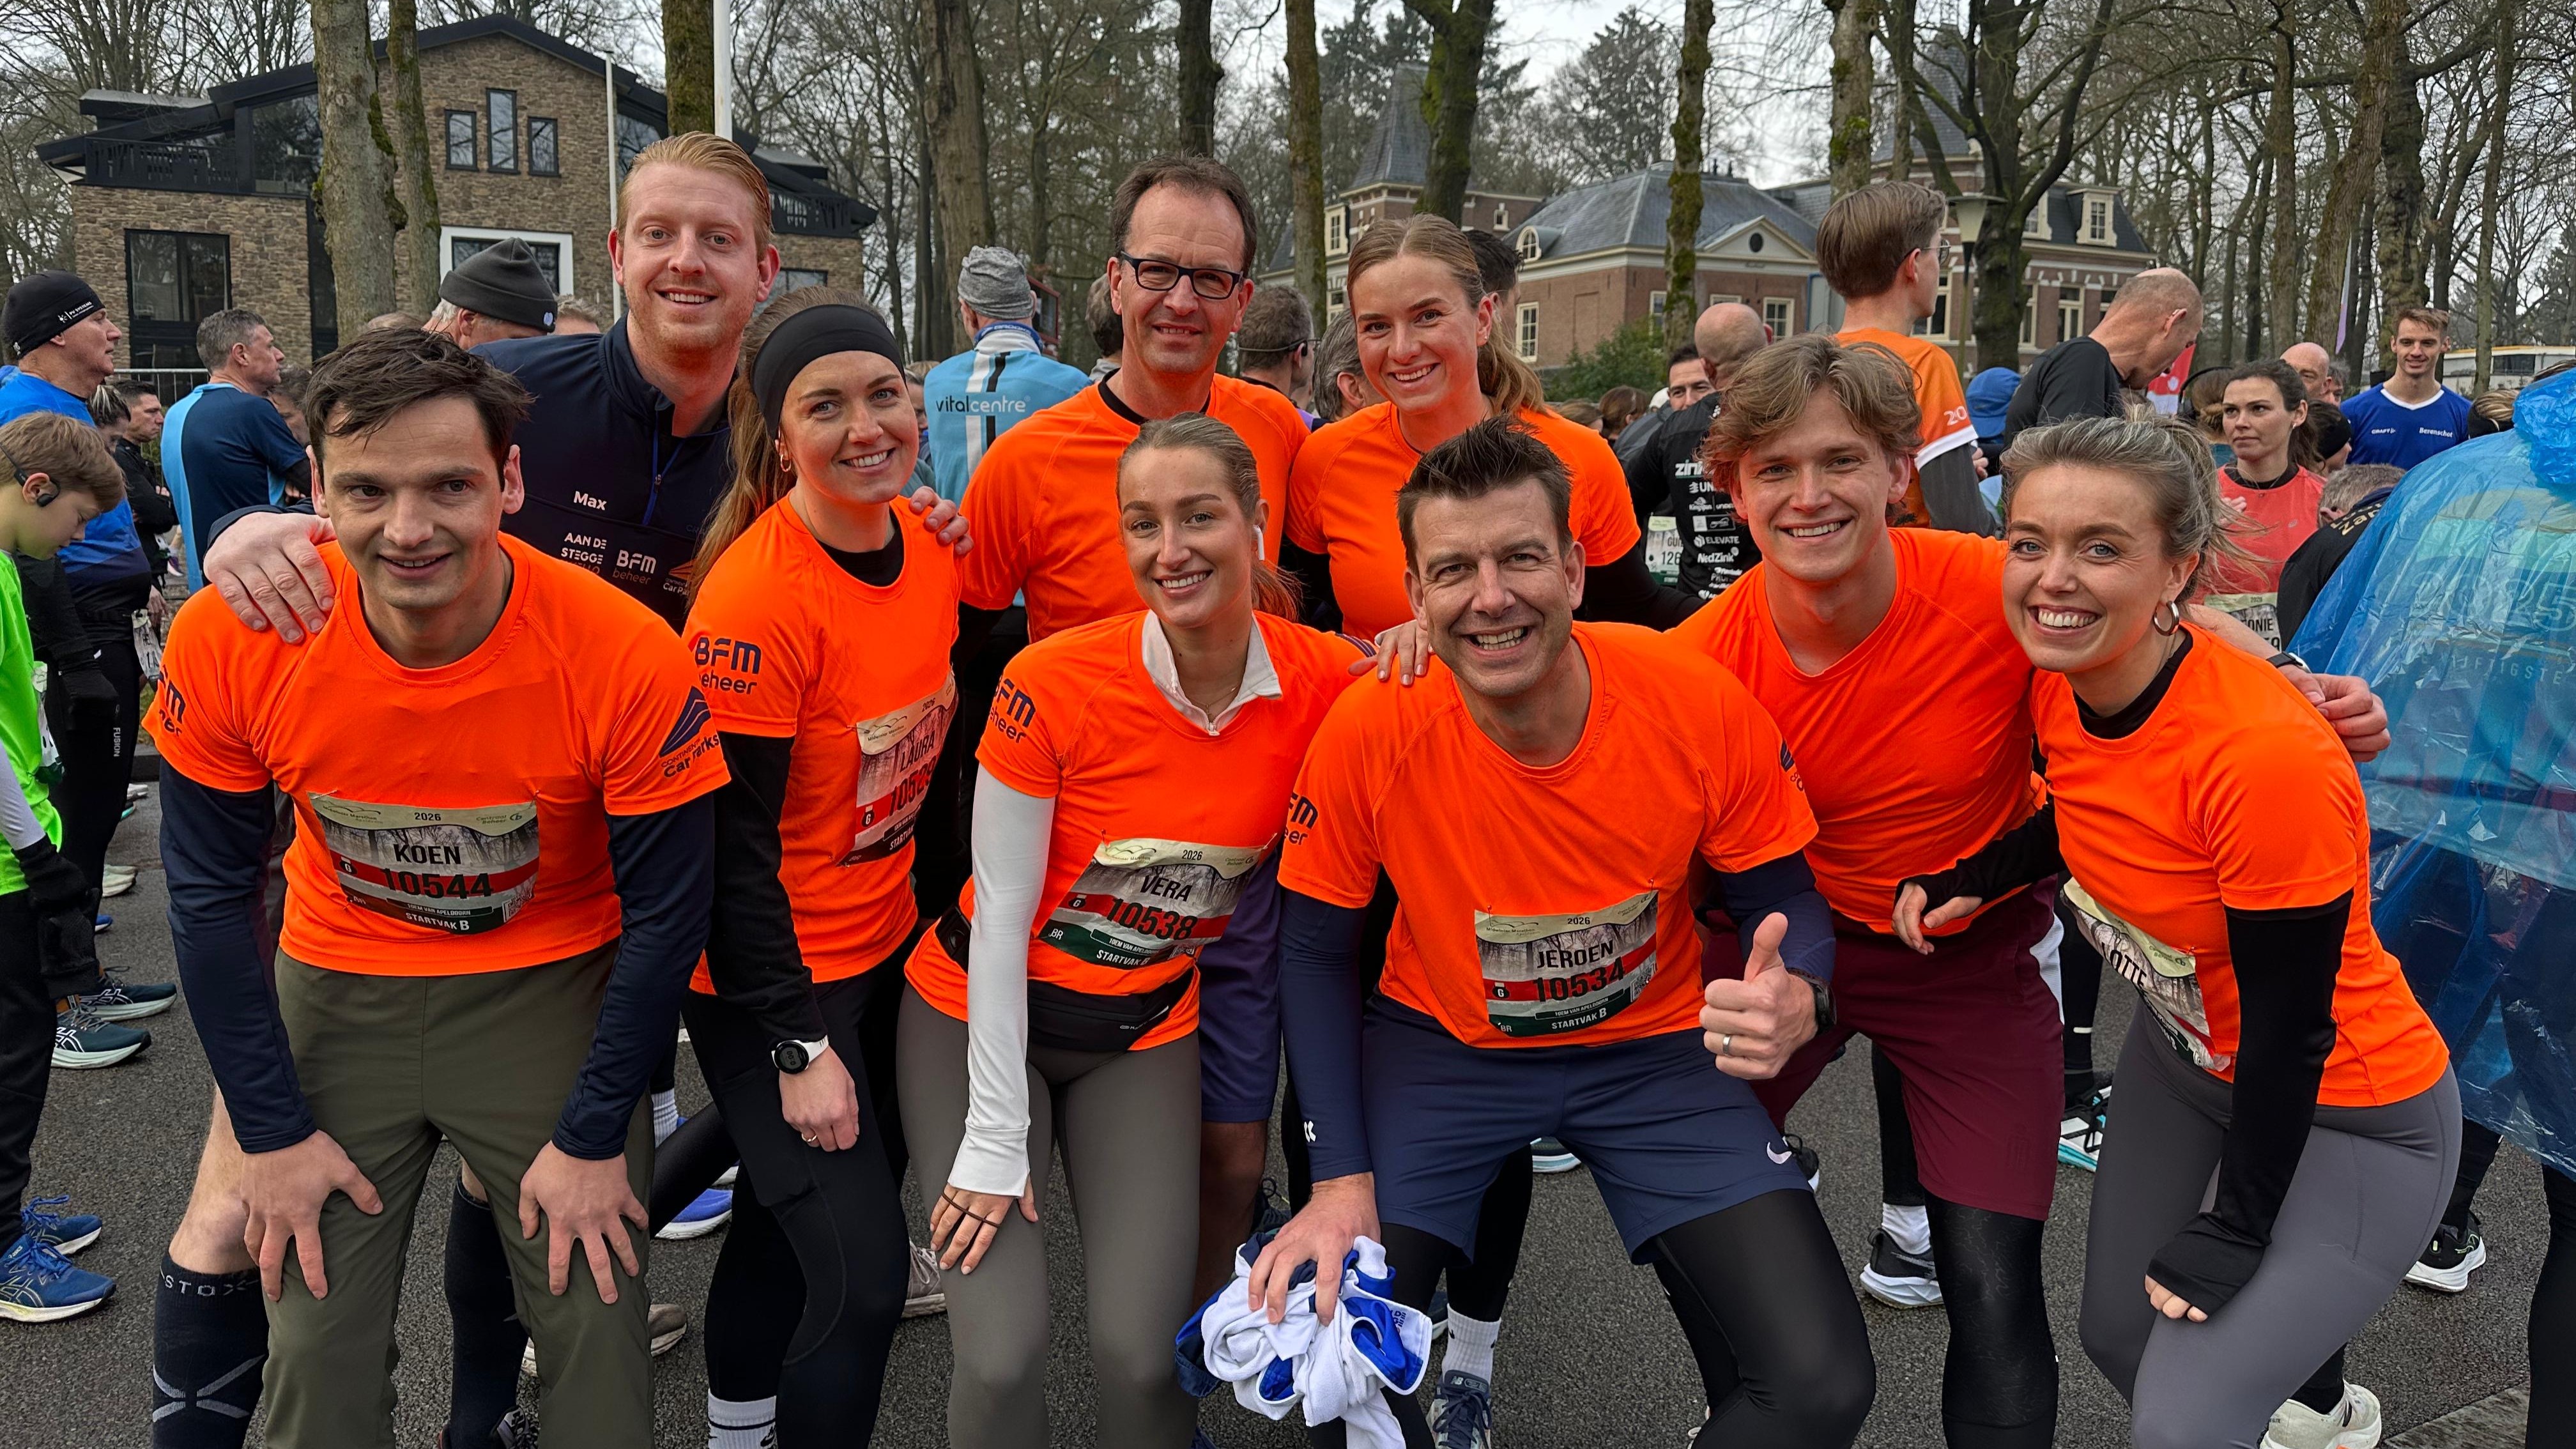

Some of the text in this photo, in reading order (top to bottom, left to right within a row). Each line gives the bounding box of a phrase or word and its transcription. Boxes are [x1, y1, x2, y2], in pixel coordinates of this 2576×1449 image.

[2419, 427, 2453, 438] Berenschot
[574, 491, 607, 510] Max
[564, 533, 607, 549] AAN DE
[1705, 535, 1740, 544] ELEVATE
[561, 548, 604, 565] STEGGE
[616, 549, 657, 574] BFM
[1697, 552, 1735, 564] NedZink
[612, 567, 652, 585] beheer
[663, 583, 677, 594] Car
[695, 636, 762, 675] BFM
[700, 670, 758, 695] eheer
[997, 678, 1036, 728] FM
[113, 727, 121, 757] FUSION
[900, 730, 935, 773] LAURA
[664, 758, 691, 778] Car
[414, 812, 442, 822] 2026
[393, 843, 462, 865] KOEN
[1183, 849, 1203, 861] 2026
[381, 868, 494, 900] 10544
[1140, 875, 1193, 902] VERA
[1073, 899, 1080, 908] G
[405, 912, 471, 931] STARTVAK B
[1106, 898, 1199, 940] 10538
[1567, 916, 1591, 925] 2026
[1050, 928, 1064, 940] BR
[1108, 937, 1123, 948] 10EM
[1123, 942, 1134, 951] VAN
[1096, 949, 1142, 966] STARTVAK
[1537, 939, 1614, 969] JEROEN
[1533, 956, 1625, 1003] 10534
[1497, 988, 1505, 998] G
[1581, 997, 1609, 1011] APELDOORN
[1551, 1007, 1607, 1030] STARTVAK B
[1500, 1024, 1513, 1033] BR
